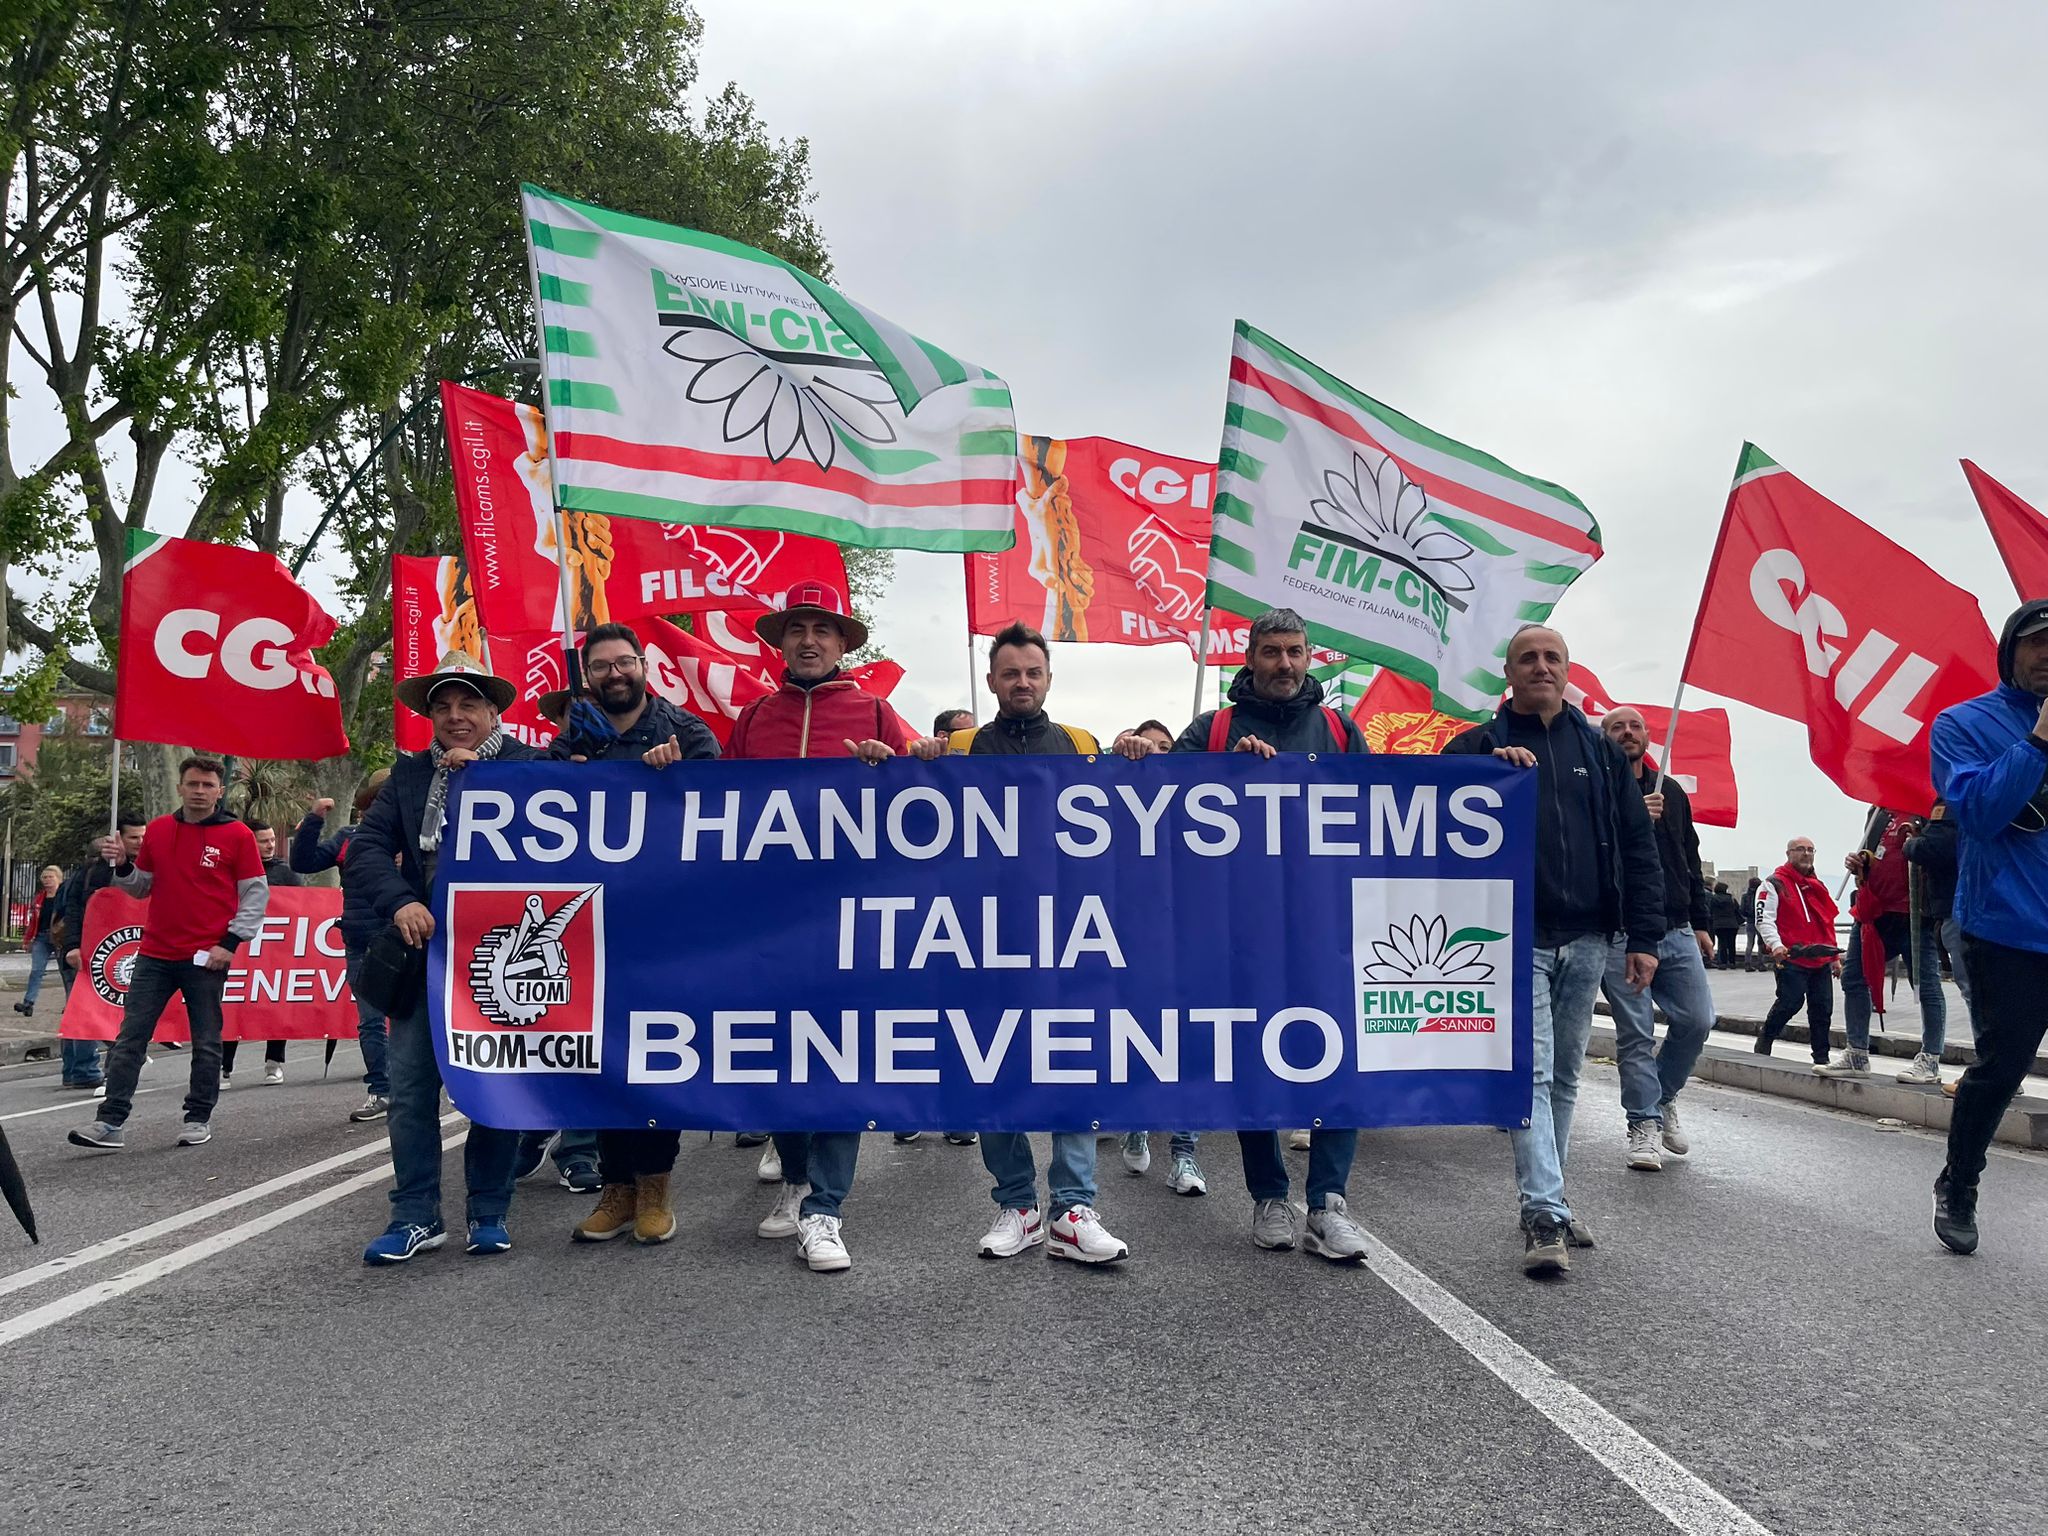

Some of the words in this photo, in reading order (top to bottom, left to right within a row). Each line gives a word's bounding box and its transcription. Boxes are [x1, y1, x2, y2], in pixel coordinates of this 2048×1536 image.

[463, 420, 501, 590] www.filcams.cgil.it
[1109, 457, 1210, 509] CGI
[1282, 574, 1356, 608] FEDERAZIONE
[1357, 600, 1405, 622] ITALIANA
[1287, 532, 1451, 646] FIM-CISL
[644, 642, 745, 721] GIL
[1749, 548, 1940, 746] CGIL
[453, 789, 647, 864] RSU
[680, 786, 1019, 862] HANON
[1054, 783, 1504, 859] SYSTEMS
[91, 927, 142, 996] OSTINATAMEN
[837, 895, 1128, 970] ITALIA
[515, 981, 566, 1002] FIOM
[1362, 990, 1496, 1015] FIM-CISL
[1366, 1019, 1411, 1033] IRPINIA
[1439, 1018, 1494, 1032] SANNIO
[452, 1032, 600, 1070] FIOM-CGIL
[626, 1006, 1345, 1086] BENEVENTO
